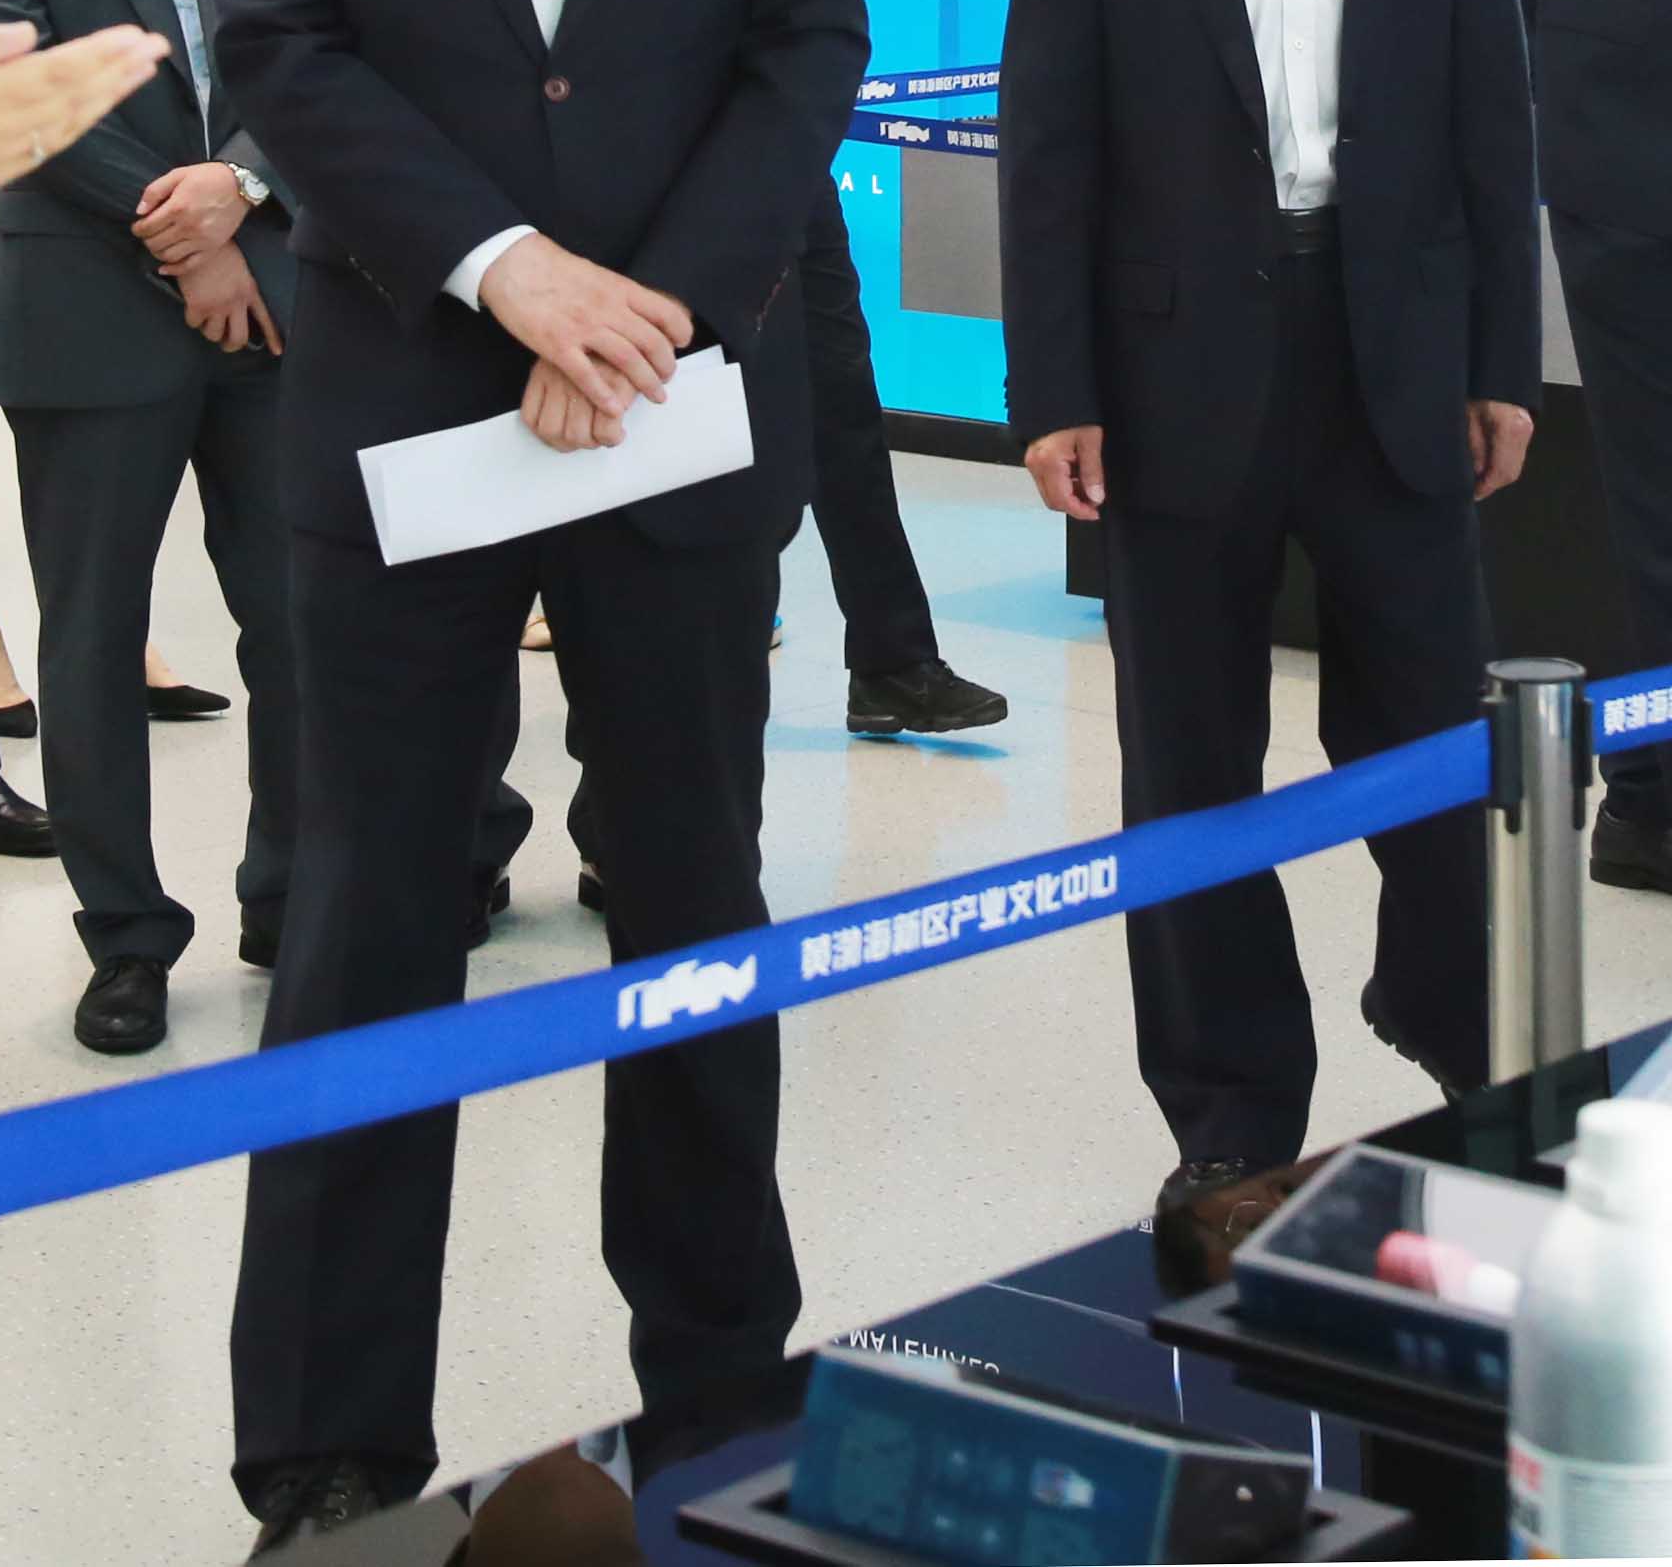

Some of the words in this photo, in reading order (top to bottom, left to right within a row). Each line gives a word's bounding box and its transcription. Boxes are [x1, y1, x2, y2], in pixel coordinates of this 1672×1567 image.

[801, 855, 1118, 981] 黄渤海新区产业文化中心
